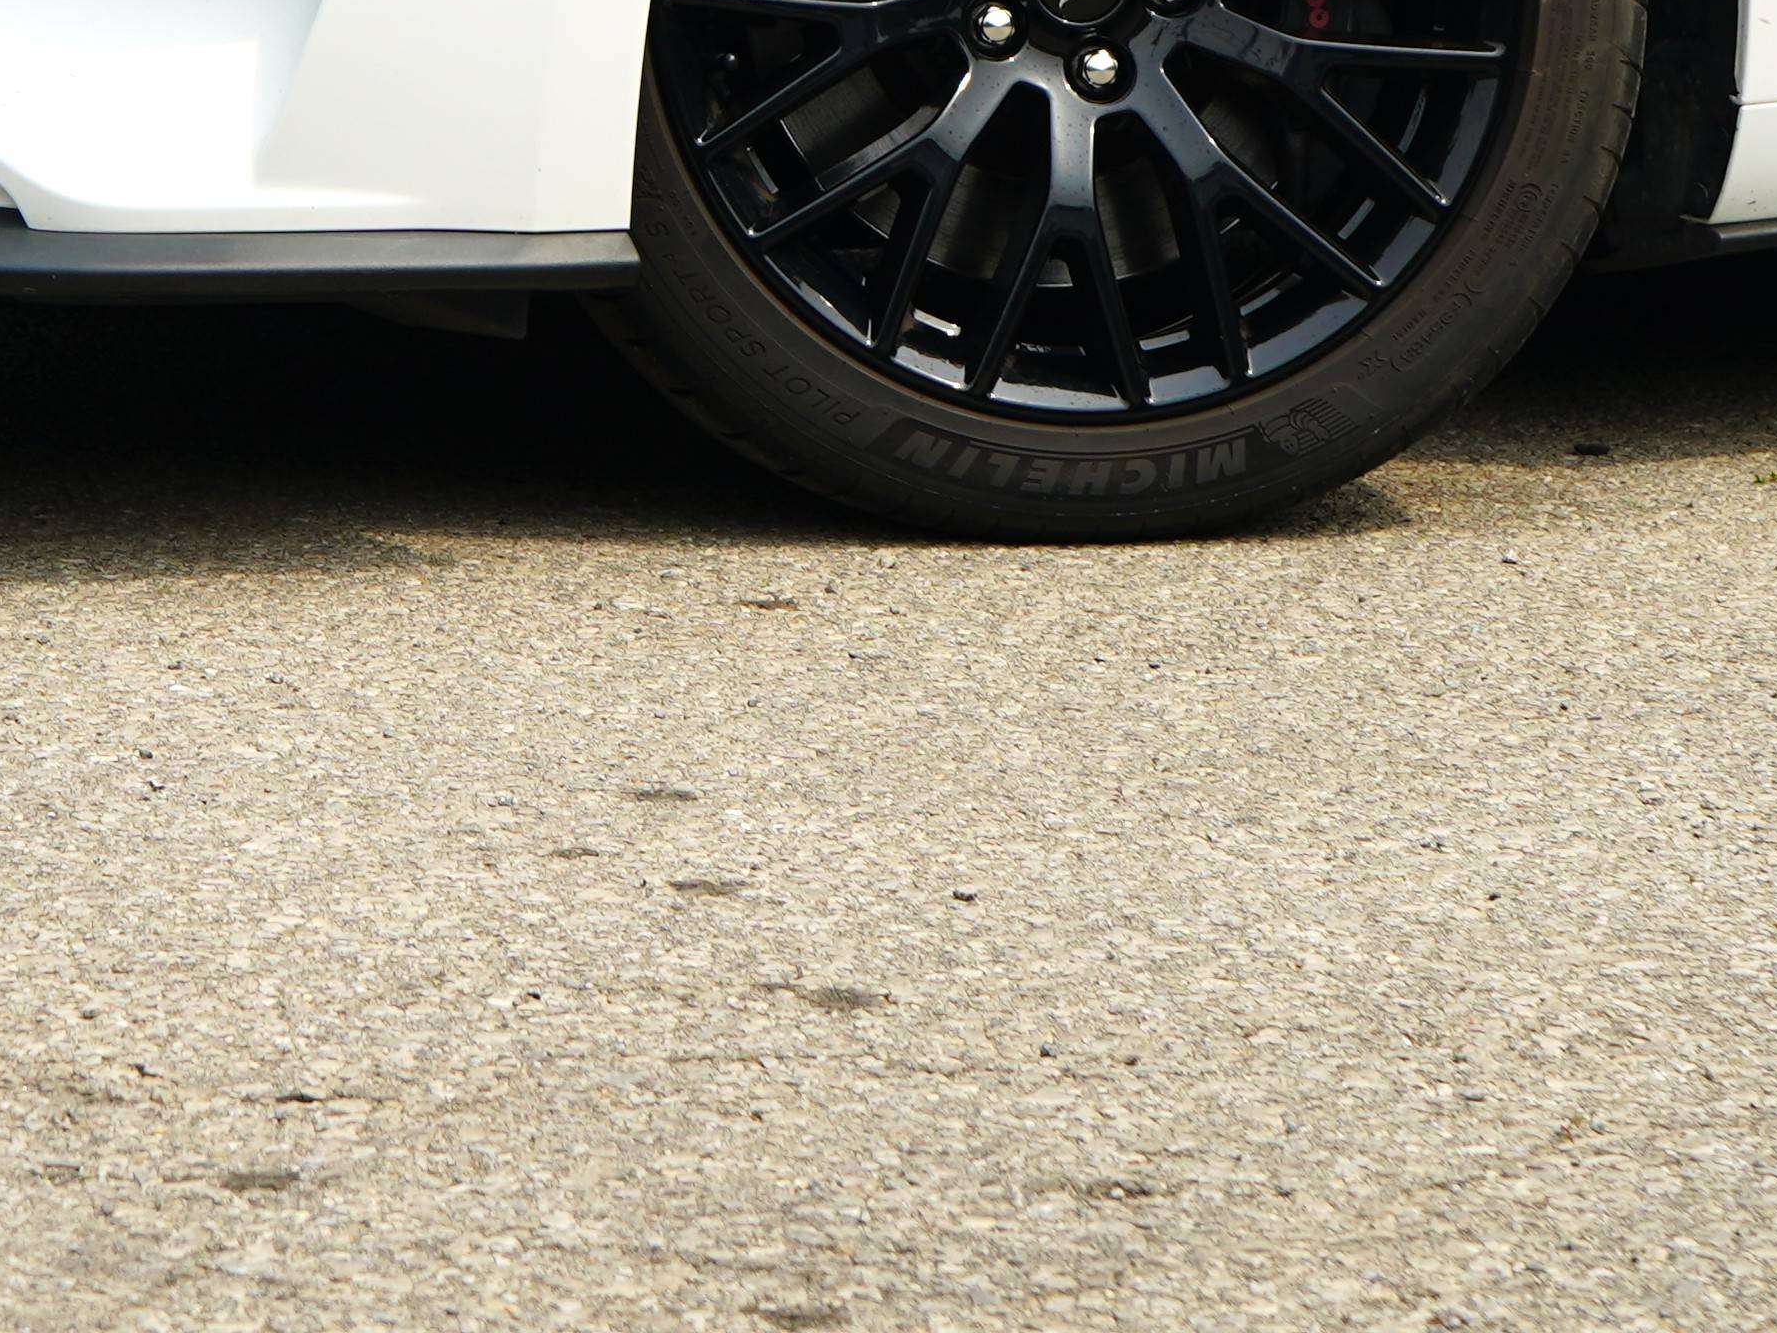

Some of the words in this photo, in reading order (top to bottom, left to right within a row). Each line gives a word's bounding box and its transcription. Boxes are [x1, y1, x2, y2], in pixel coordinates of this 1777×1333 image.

[672, 262, 768, 358] SPORT
[763, 360, 861, 427] PILOT
[894, 431, 1248, 497] MICHELIN
